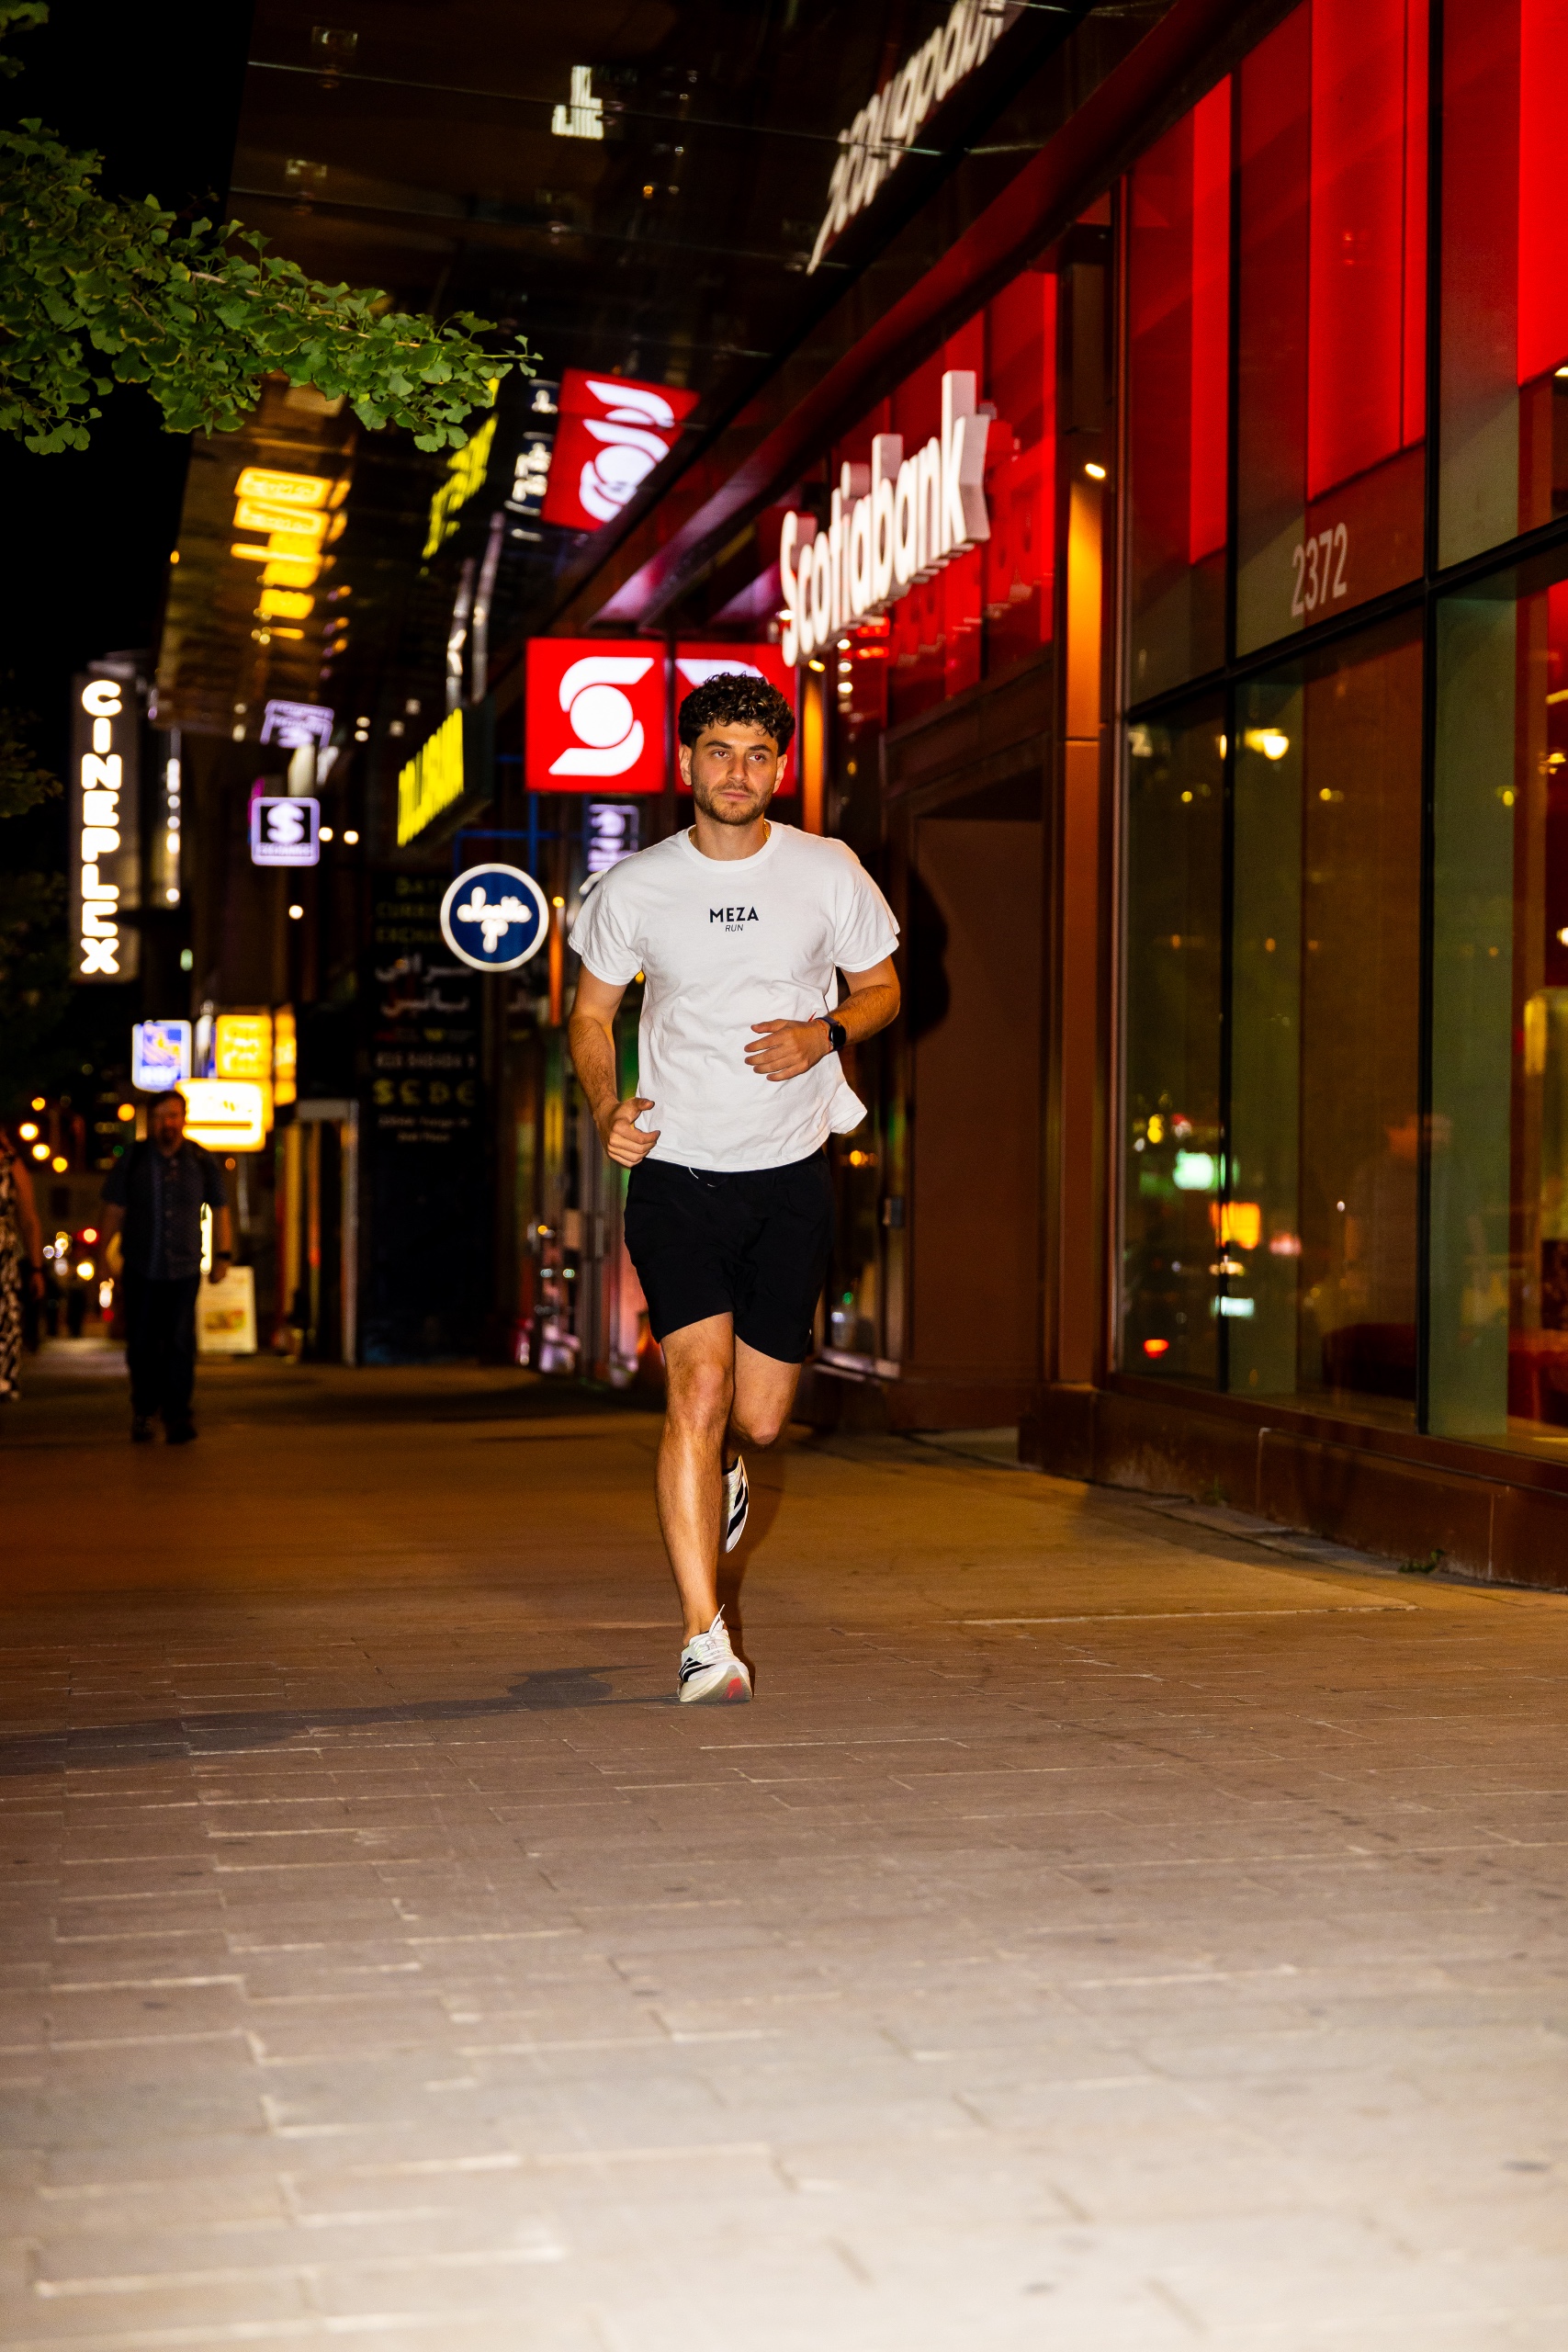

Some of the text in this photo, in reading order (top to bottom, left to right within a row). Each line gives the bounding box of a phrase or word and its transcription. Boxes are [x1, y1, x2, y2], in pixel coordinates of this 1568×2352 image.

[779, 369, 985, 667] Scotiabank
[1291, 522, 1348, 617] 2372
[81, 679, 122, 975] CINEPLEX
[709, 906, 760, 923] MEZA
[725, 923, 744, 933] RUN
